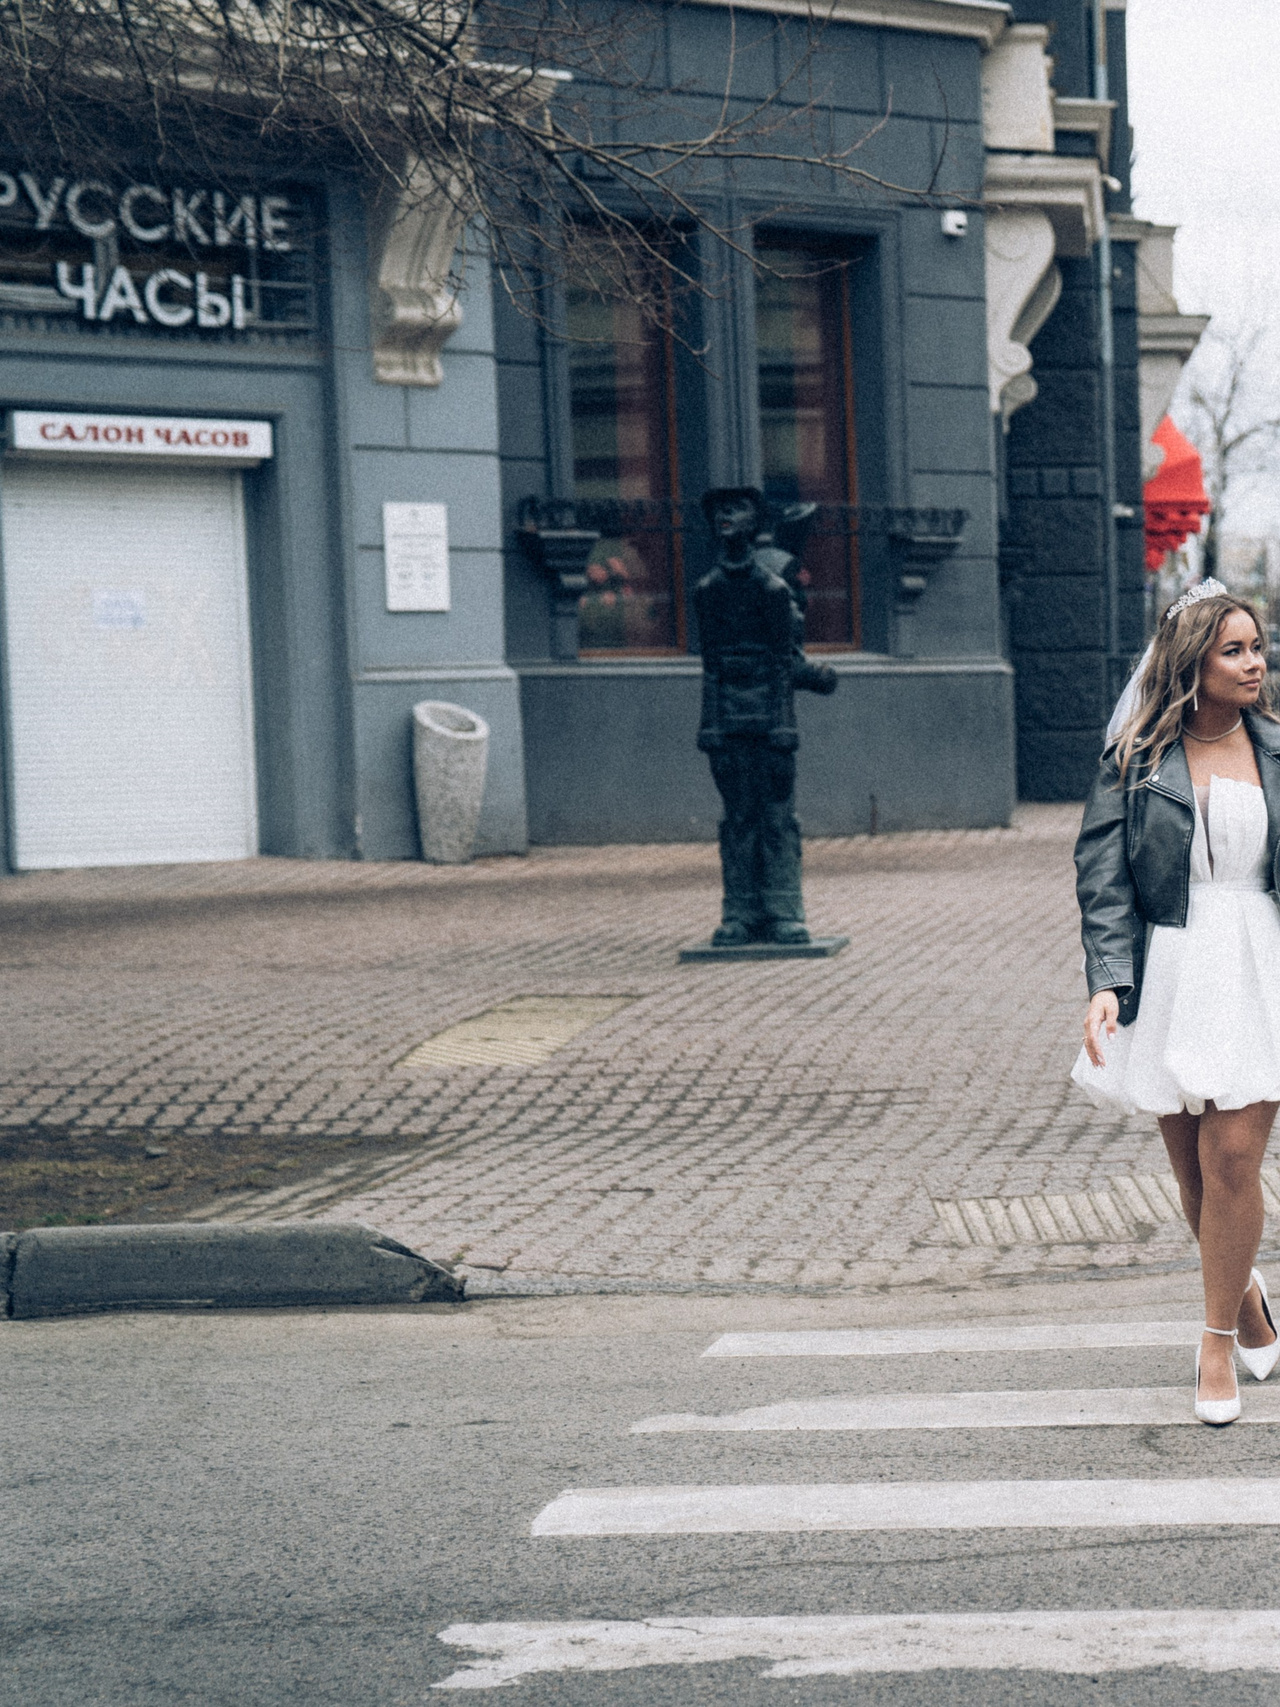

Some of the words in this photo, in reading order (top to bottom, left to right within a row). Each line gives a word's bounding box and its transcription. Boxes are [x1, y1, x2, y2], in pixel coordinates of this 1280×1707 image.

[57, 260, 245, 330] ЧАСЫ
[39, 423, 144, 444] САЛОН
[154, 427, 249, 448] ЧАСОВ
